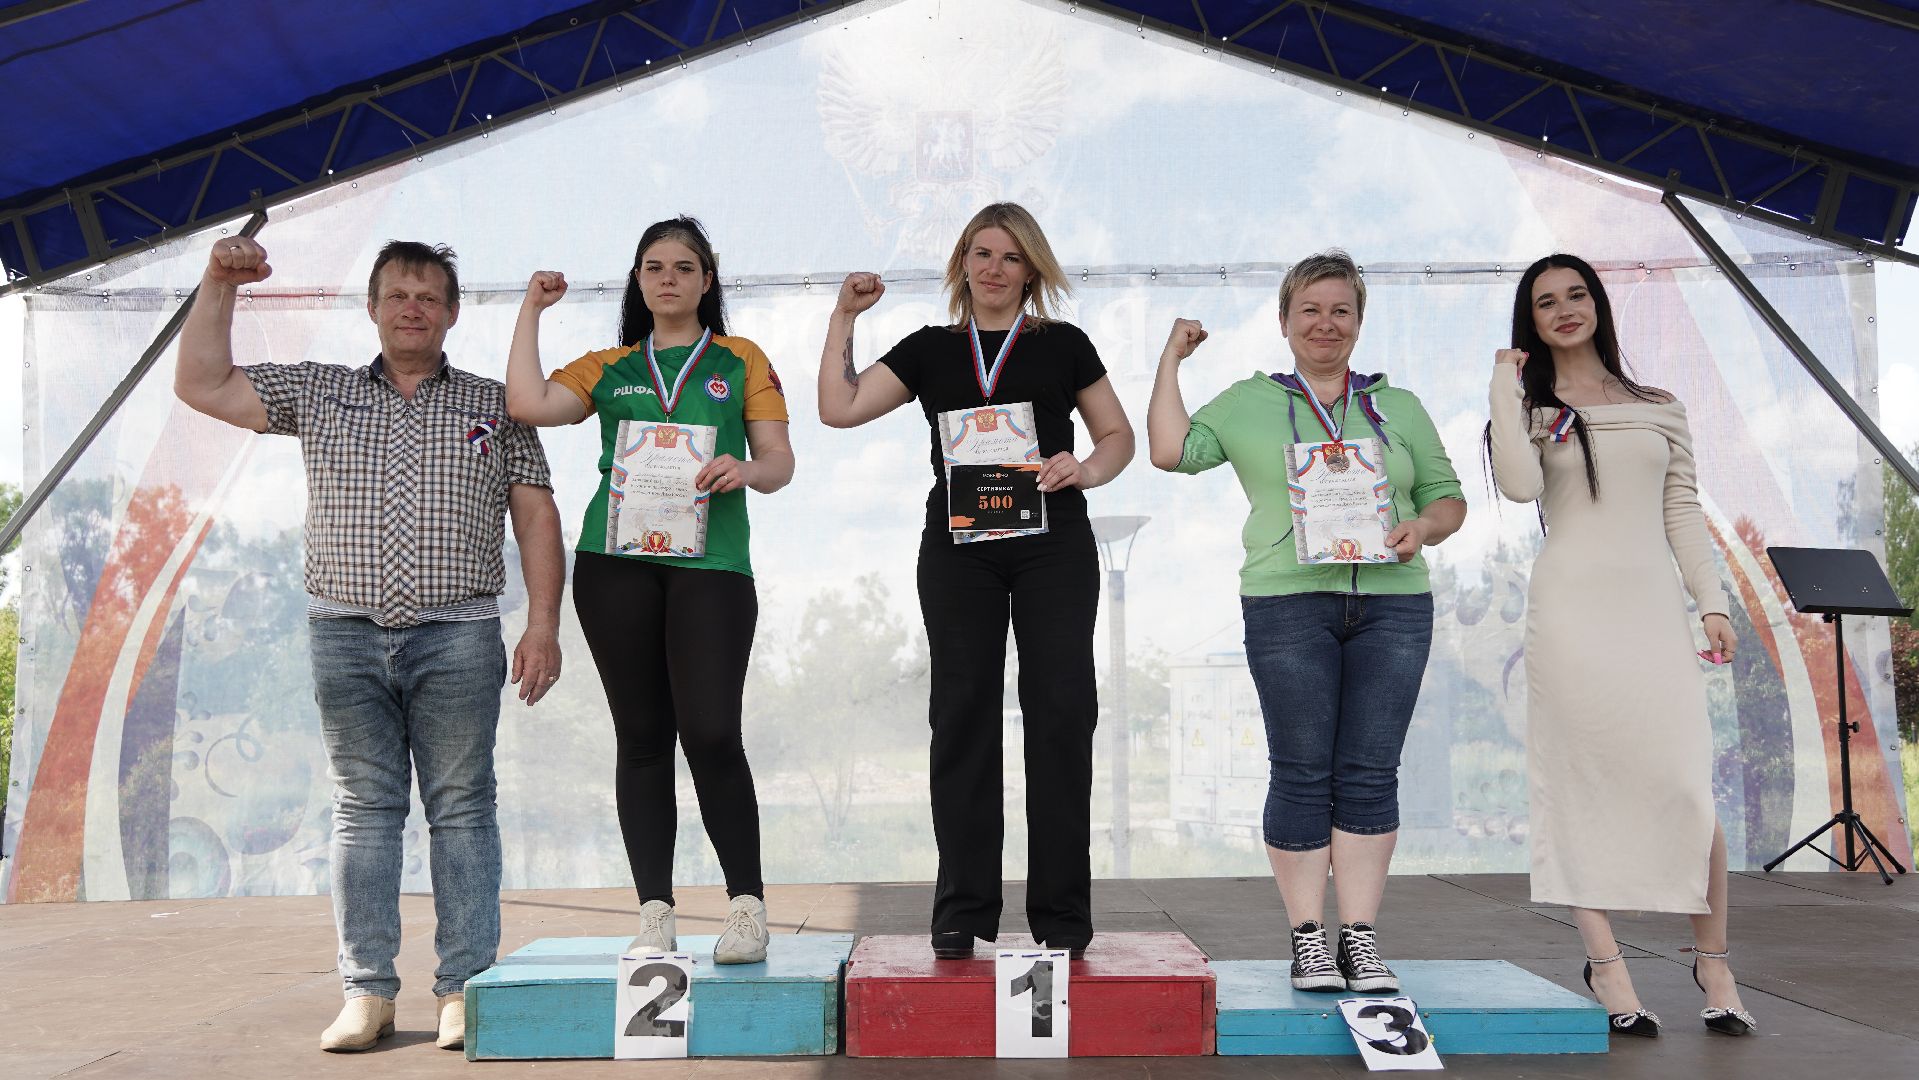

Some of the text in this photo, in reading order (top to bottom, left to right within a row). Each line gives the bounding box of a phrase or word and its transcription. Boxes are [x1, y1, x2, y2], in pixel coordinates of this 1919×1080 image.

[613, 385, 657, 398] РШФА
[978, 495, 1013, 510] 500
[624, 962, 688, 1038] 2
[1010, 960, 1053, 1038] 1
[1357, 1004, 1429, 1056] 3
